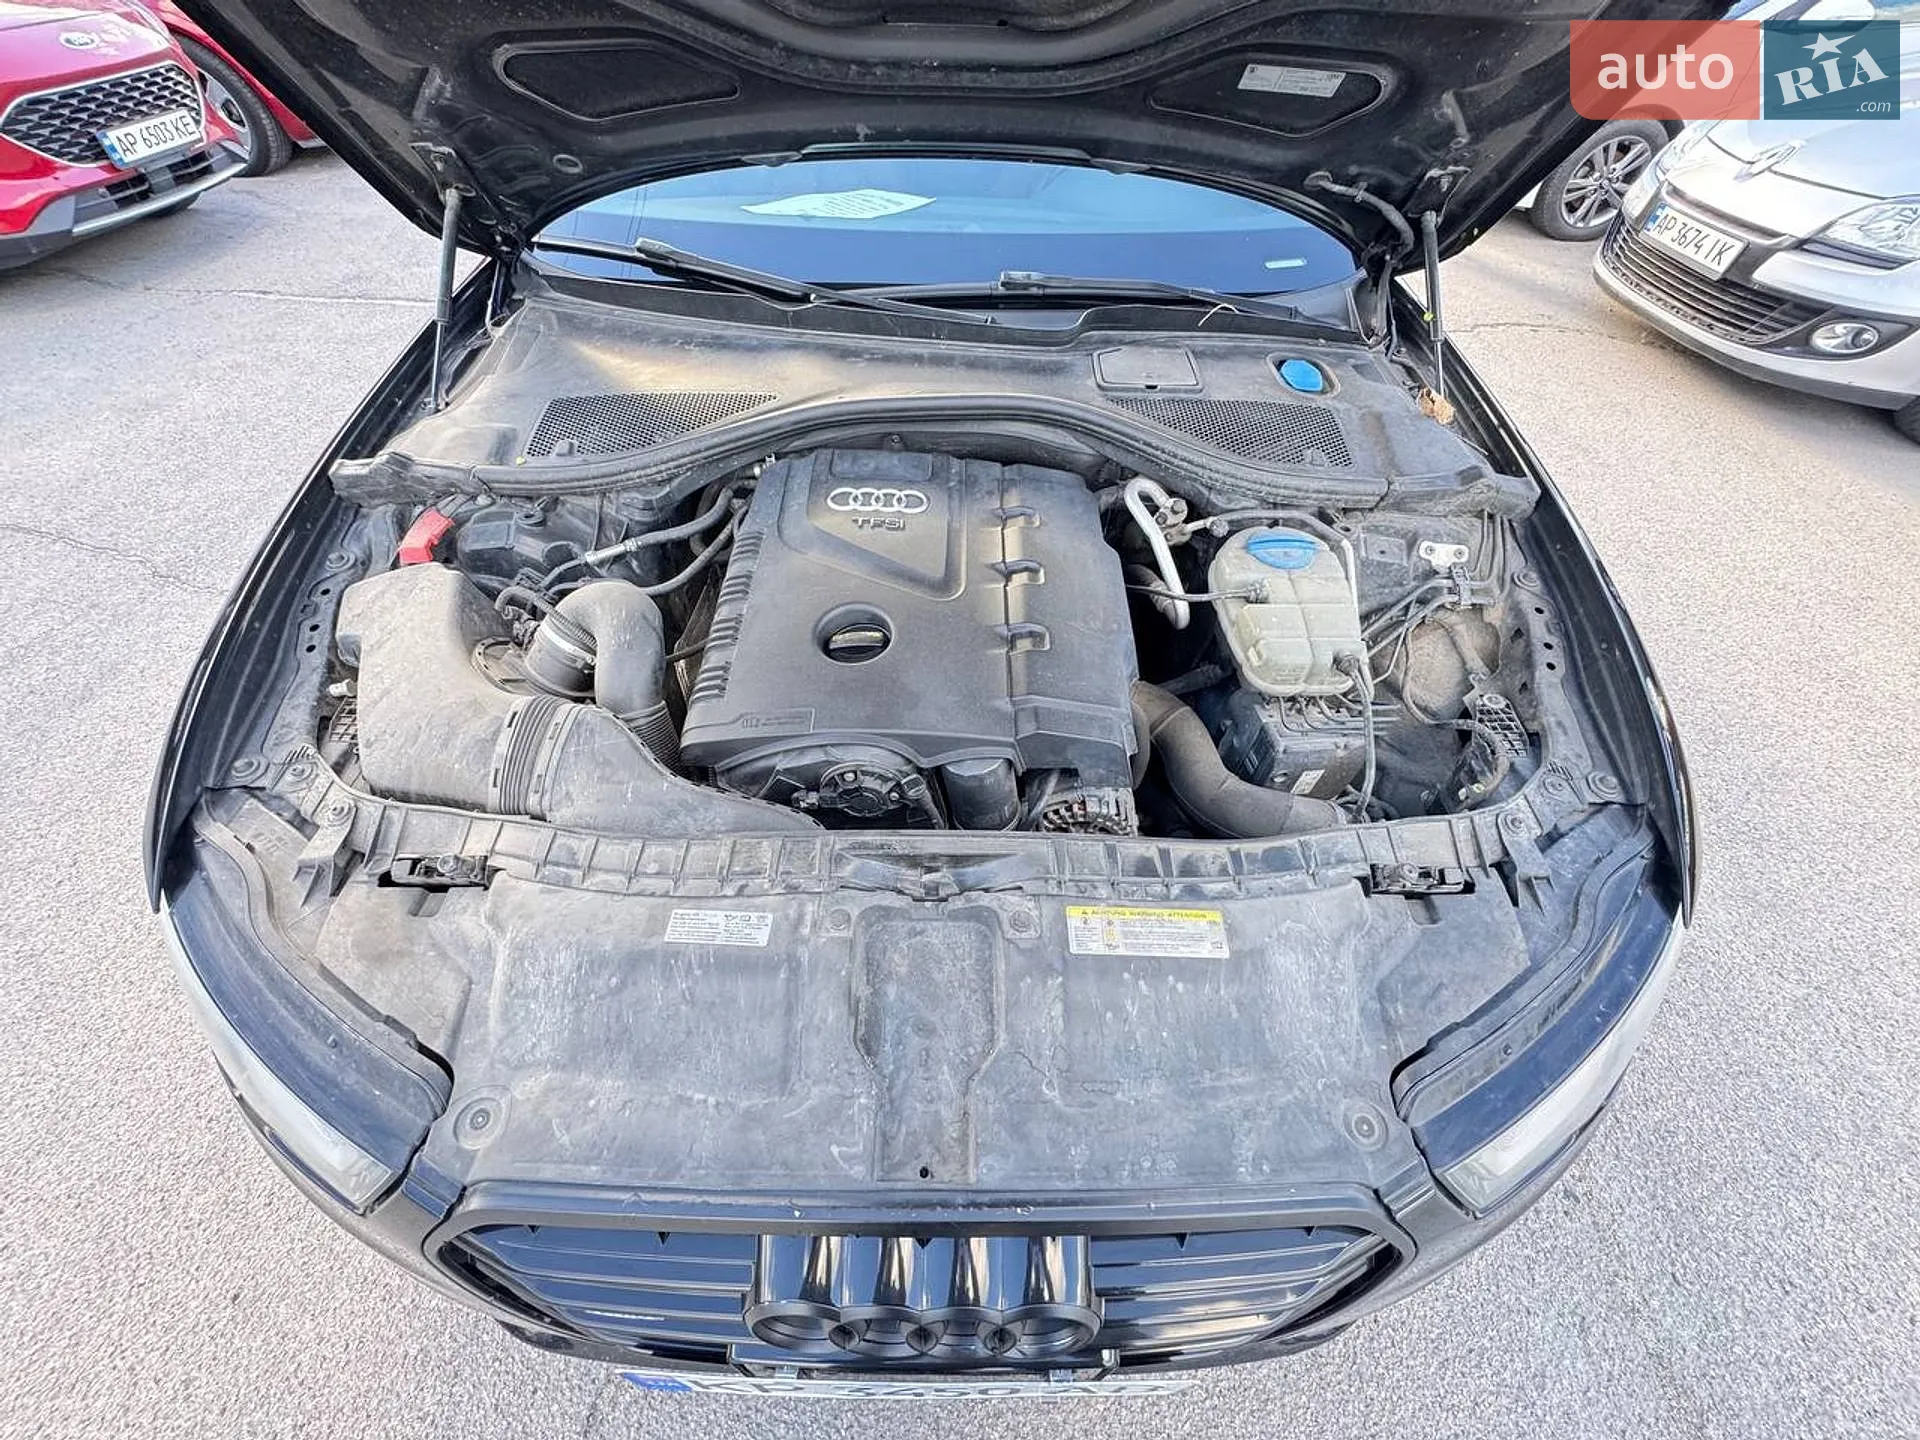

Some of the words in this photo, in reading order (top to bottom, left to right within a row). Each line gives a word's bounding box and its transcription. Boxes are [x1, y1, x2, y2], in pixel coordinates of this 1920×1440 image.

[116, 132, 139, 157] AP
[140, 121, 175, 149] 6503
[170, 115, 196, 140] KE
[1652, 213, 1677, 235] AP
[1671, 222, 1710, 255] 3674
[1703, 239, 1735, 266] IK
[851, 516, 906, 531] TFSI
